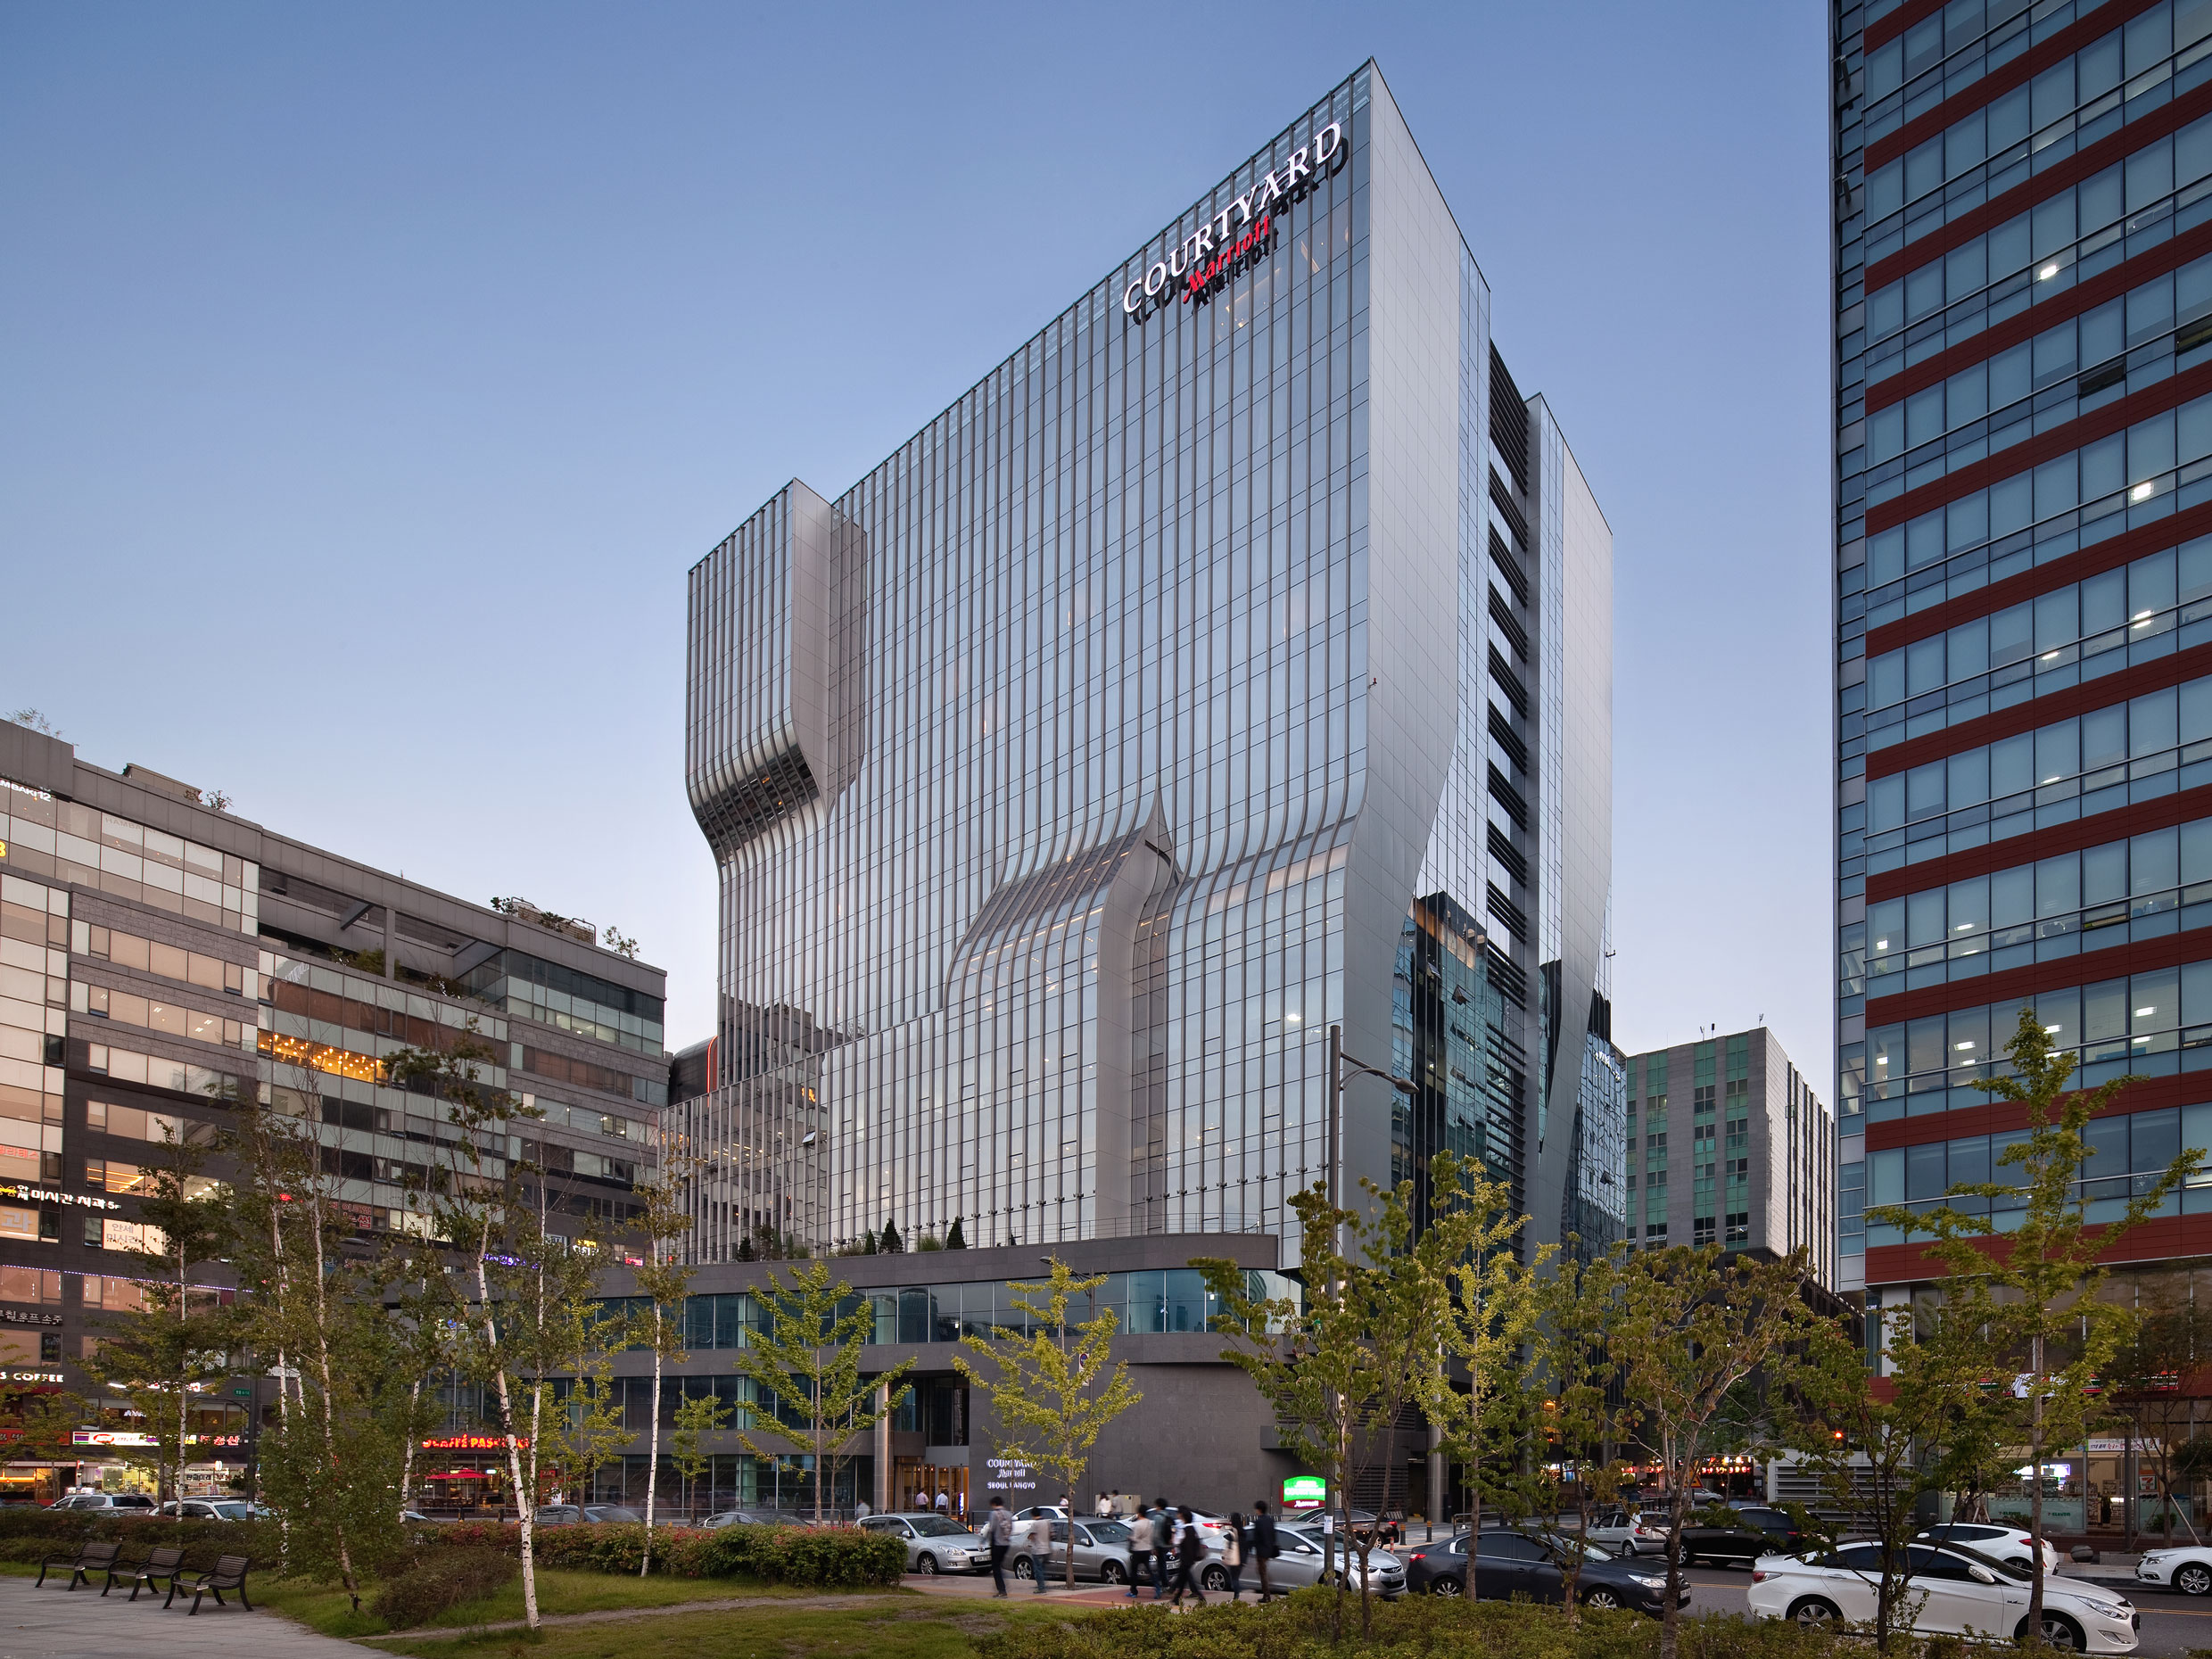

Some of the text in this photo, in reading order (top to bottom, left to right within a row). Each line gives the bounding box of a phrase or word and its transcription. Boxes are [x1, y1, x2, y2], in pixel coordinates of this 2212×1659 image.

[1123, 122, 1341, 314] COURTYARD
[1183, 214, 1269, 304] Marriott
[30, 1189, 73, 1205] 미시간
[78, 1195, 106, 1209] 치과
[111, 1223, 134, 1234] 안세
[42, 1314, 63, 1324] 소주
[13, 1372, 64, 1382] COFFEE
[987, 1482, 1008, 1490] SEOUL
